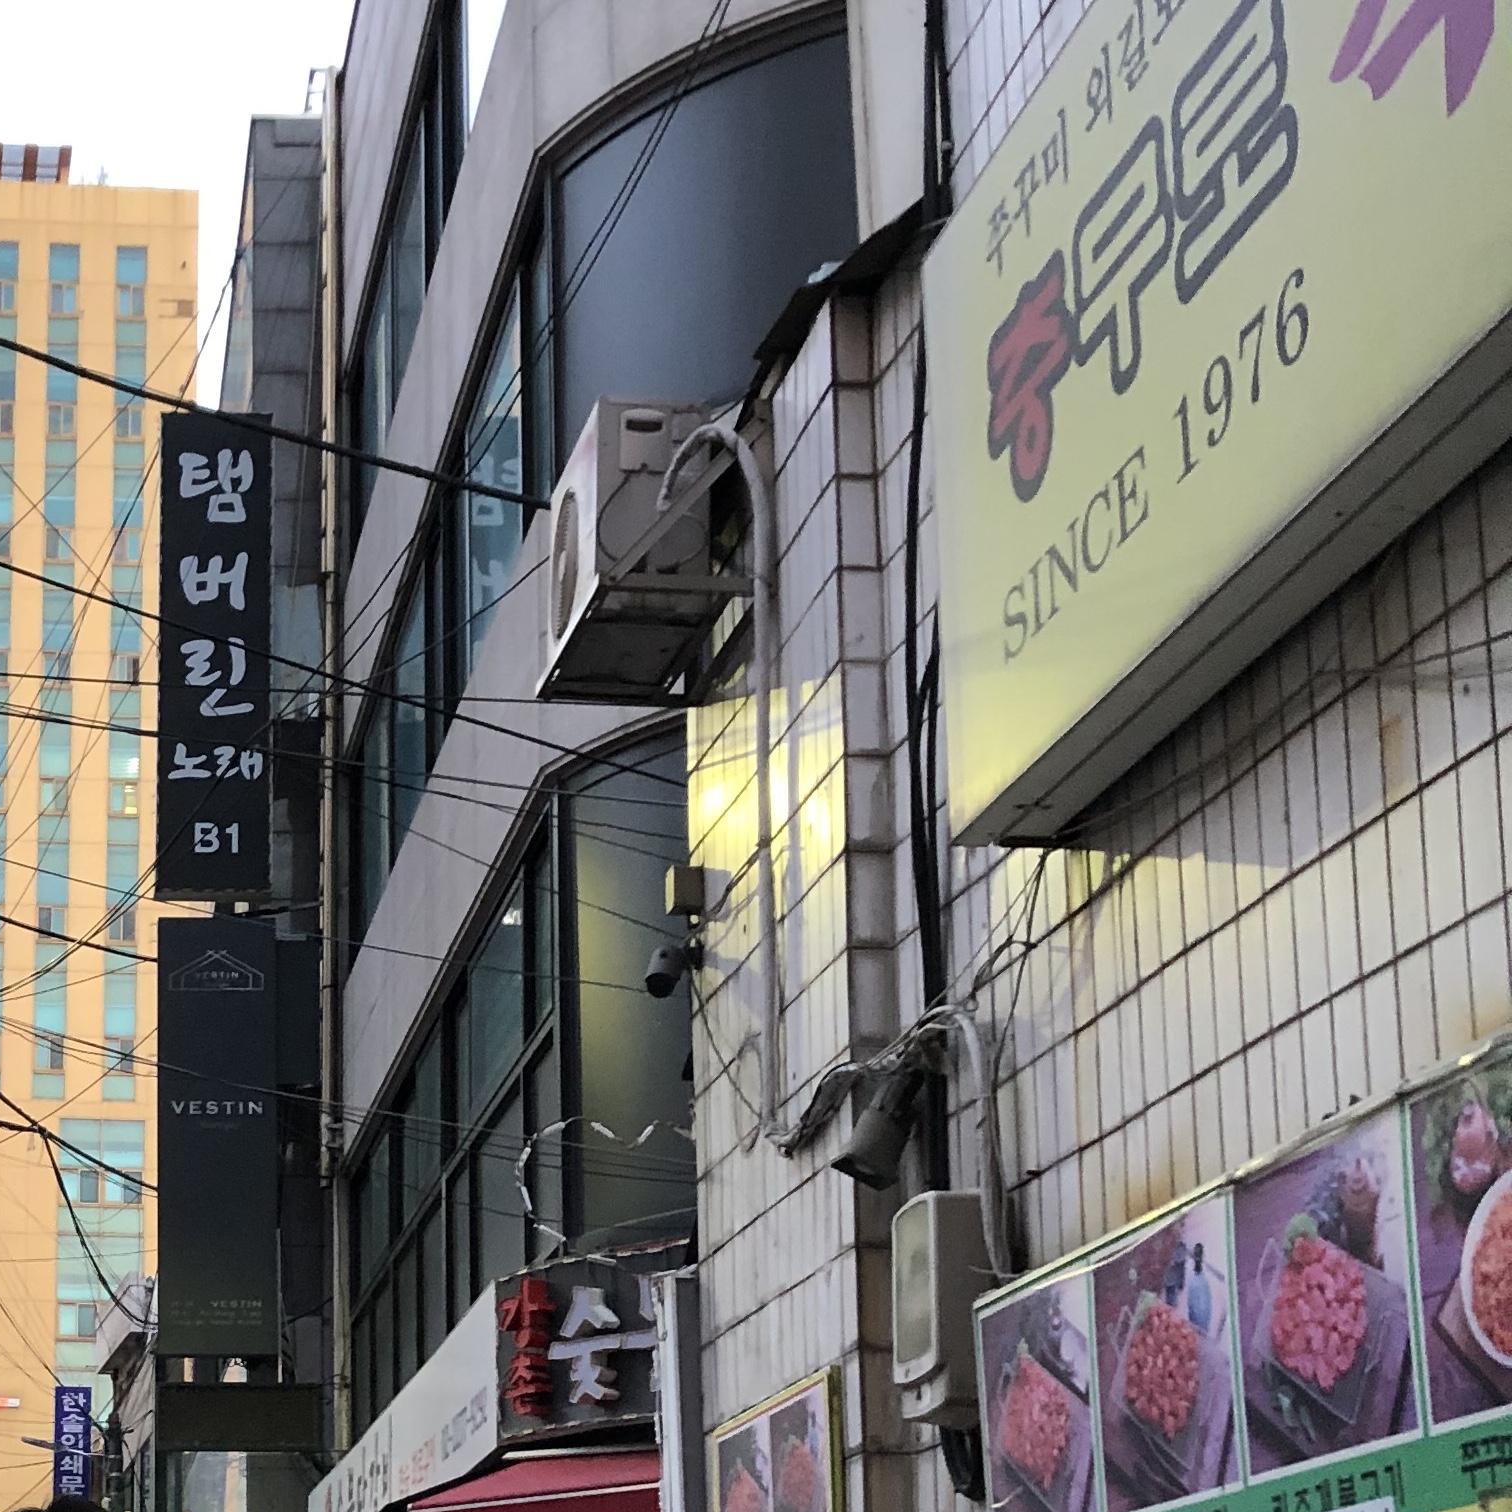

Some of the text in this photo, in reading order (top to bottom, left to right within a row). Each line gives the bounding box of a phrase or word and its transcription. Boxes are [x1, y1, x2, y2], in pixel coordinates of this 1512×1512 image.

[1001, 267, 1311, 664] SINCE 1976
[178, 448, 256, 718] 탬버린
[168, 742, 263, 782] 노래
[193, 821, 240, 854] B1
[171, 1100, 264, 1116] VESTIN
